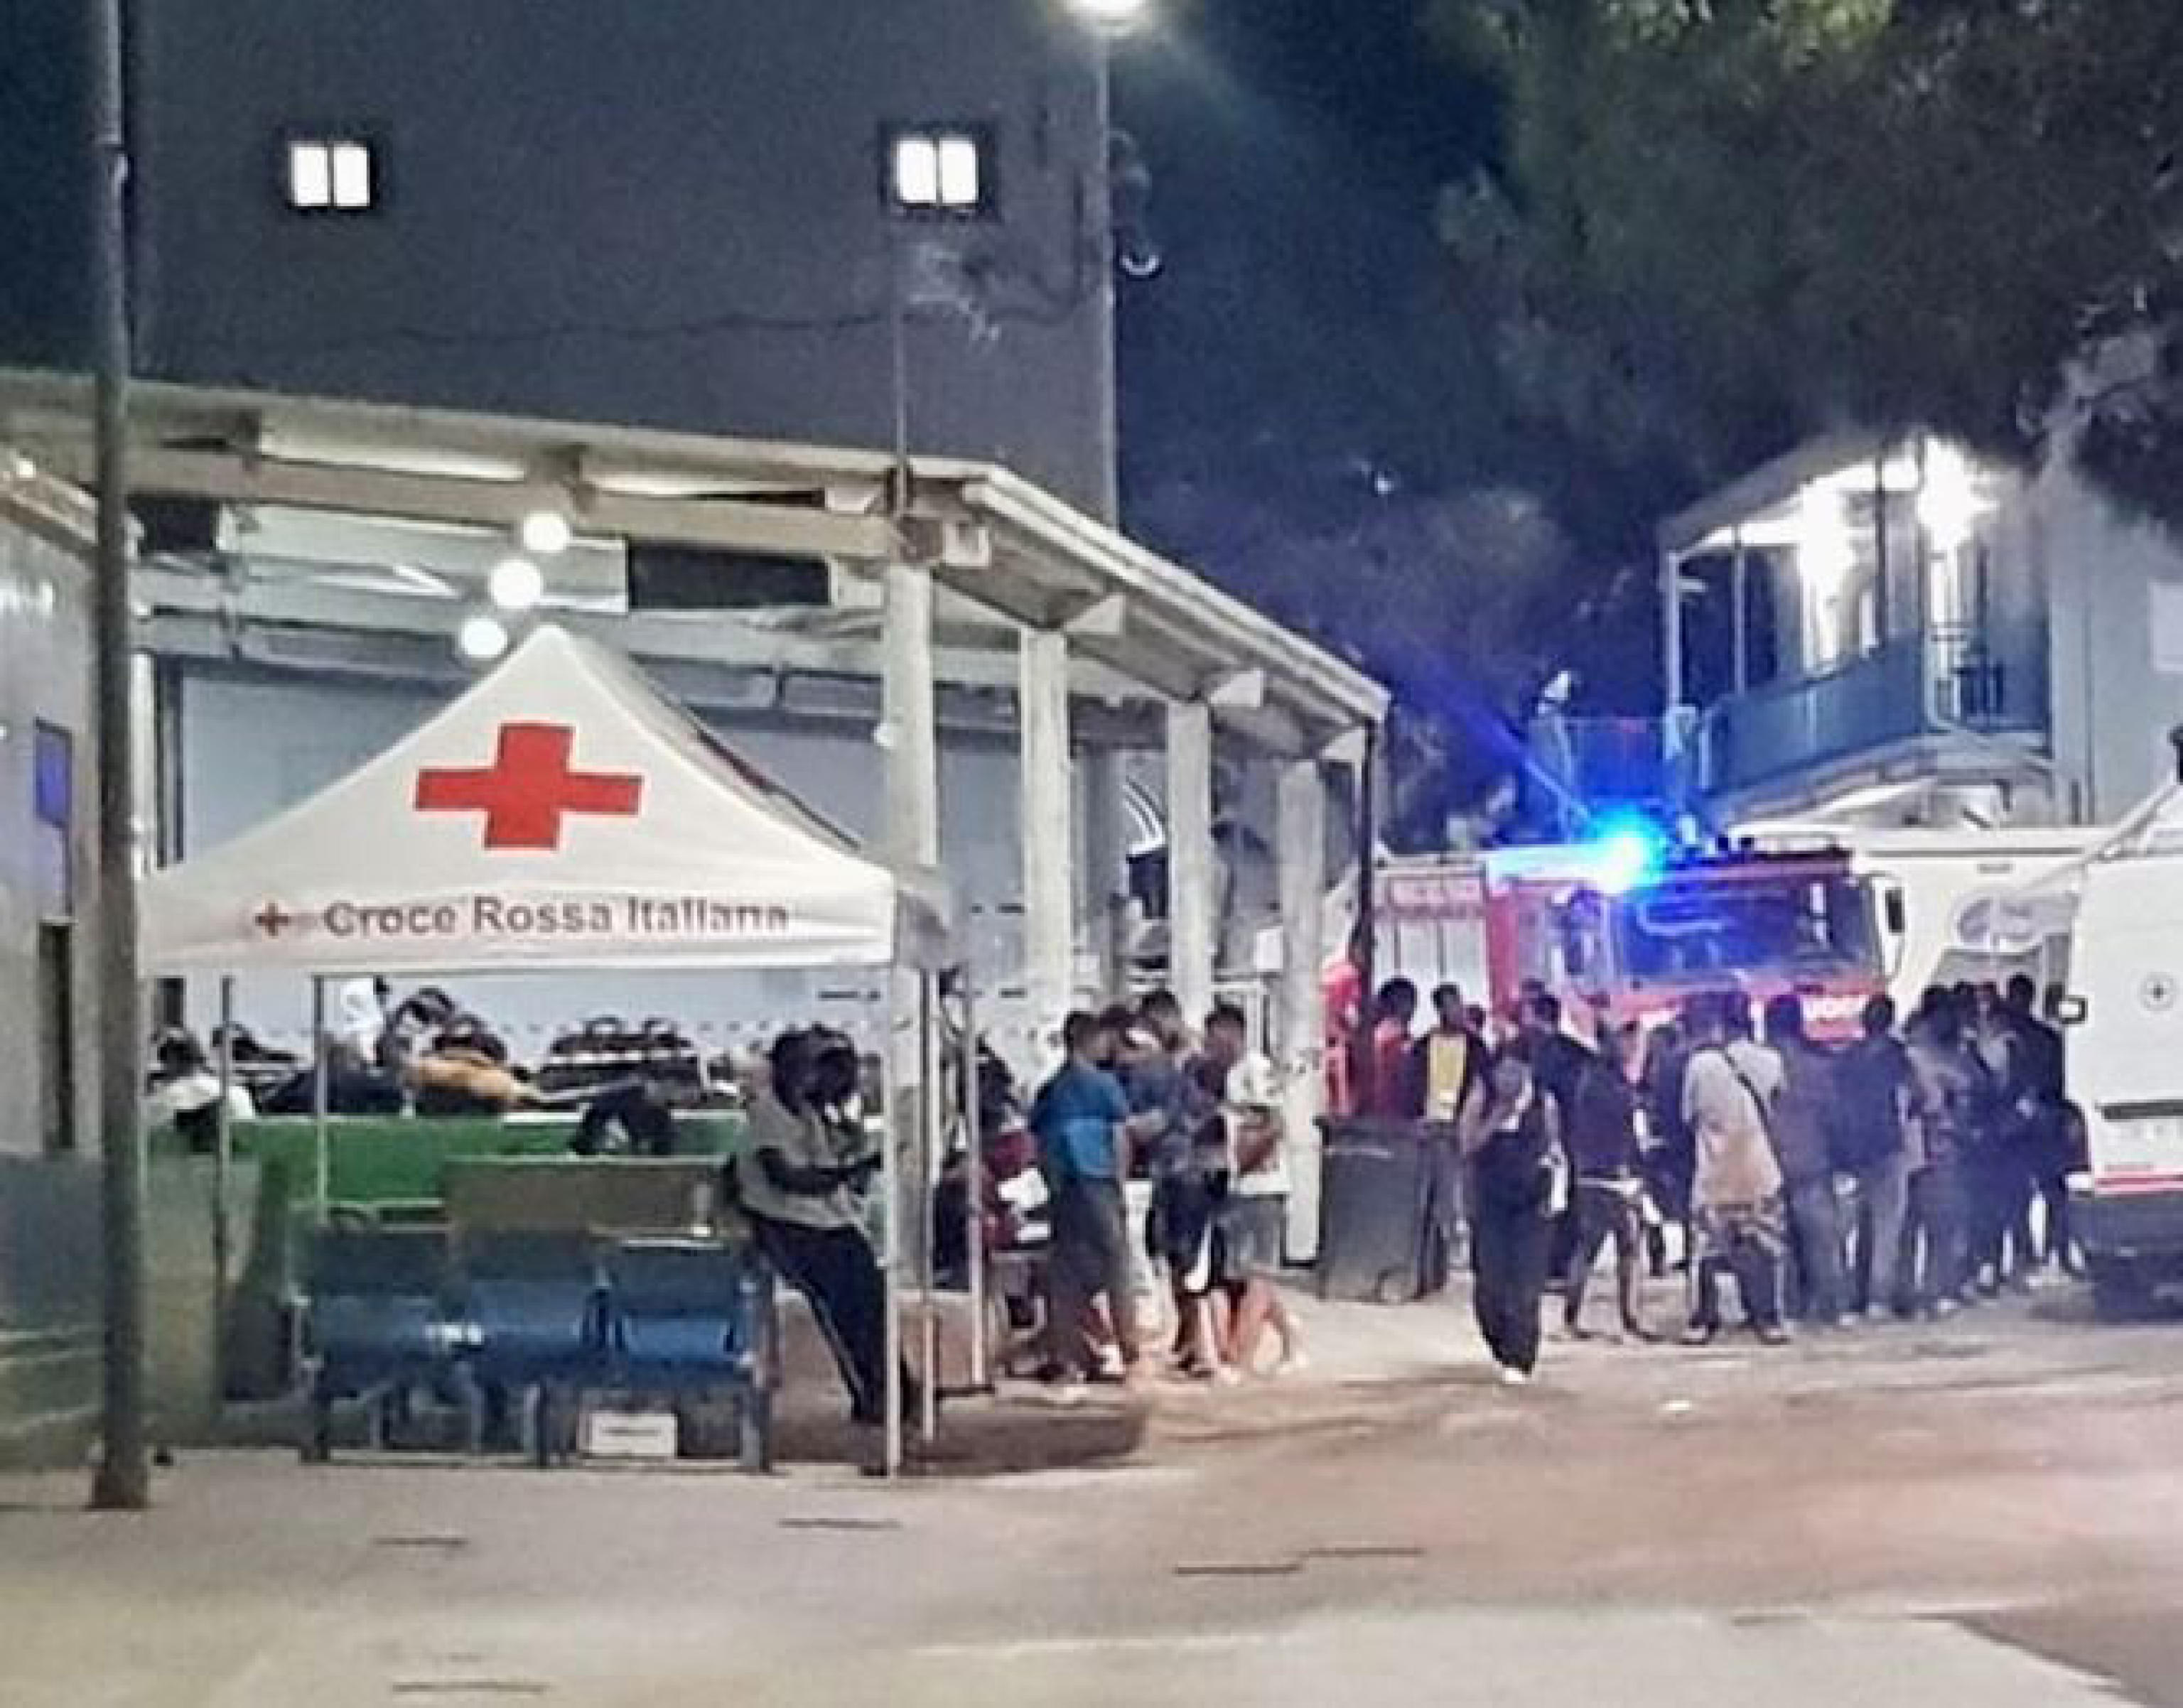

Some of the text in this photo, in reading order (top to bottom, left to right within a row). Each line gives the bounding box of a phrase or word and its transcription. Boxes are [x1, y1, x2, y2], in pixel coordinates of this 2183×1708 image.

[323, 896, 789, 936] Croce Rossa Italiana
